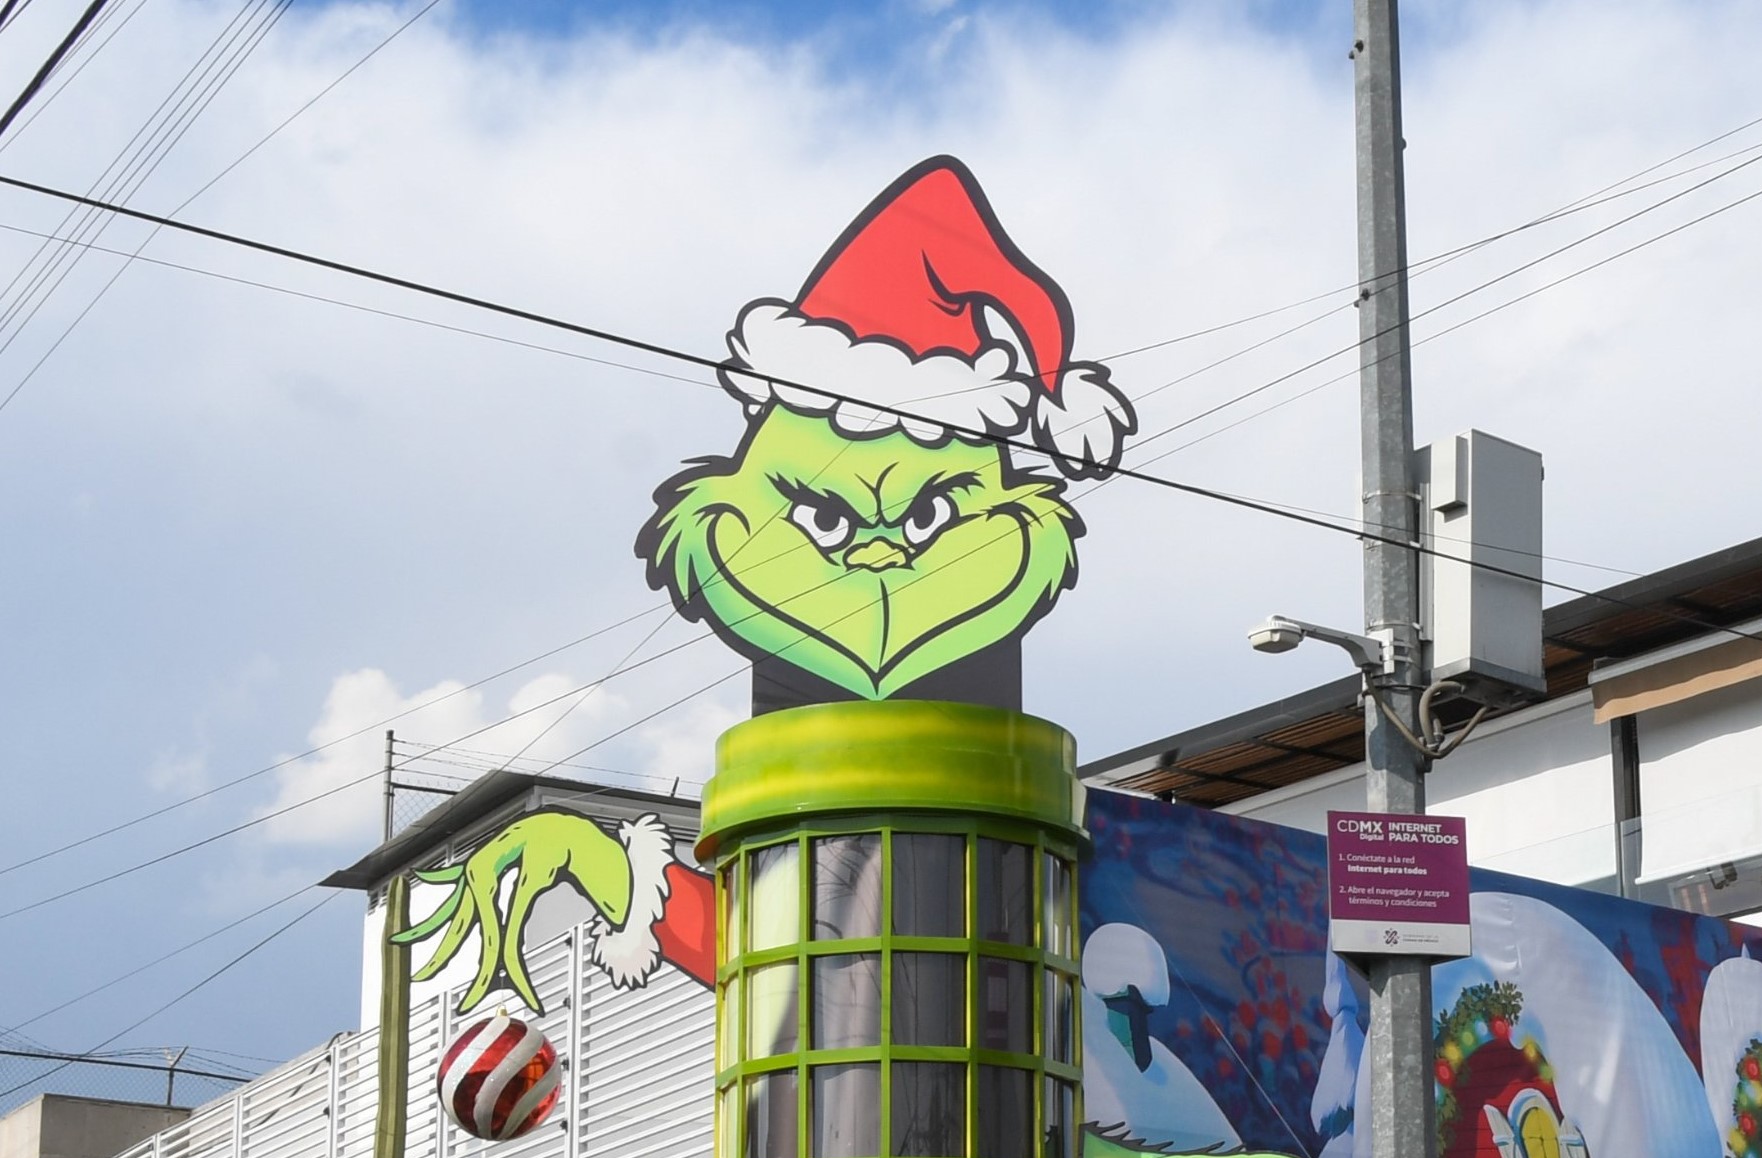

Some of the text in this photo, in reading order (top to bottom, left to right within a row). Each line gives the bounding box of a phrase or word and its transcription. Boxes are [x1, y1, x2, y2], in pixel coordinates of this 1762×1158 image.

[1336, 819, 1442, 834] CDMX INTERNET
[1359, 832, 1460, 845] Digital PARA TODOS
[1338, 853, 1416, 865] 1. Conéctate a la red
[1347, 864, 1428, 876] Internet para todos
[1339, 885, 1450, 899] 2. Abre el navegador y acepta
[1348, 896, 1437, 909] términos y condiciones
